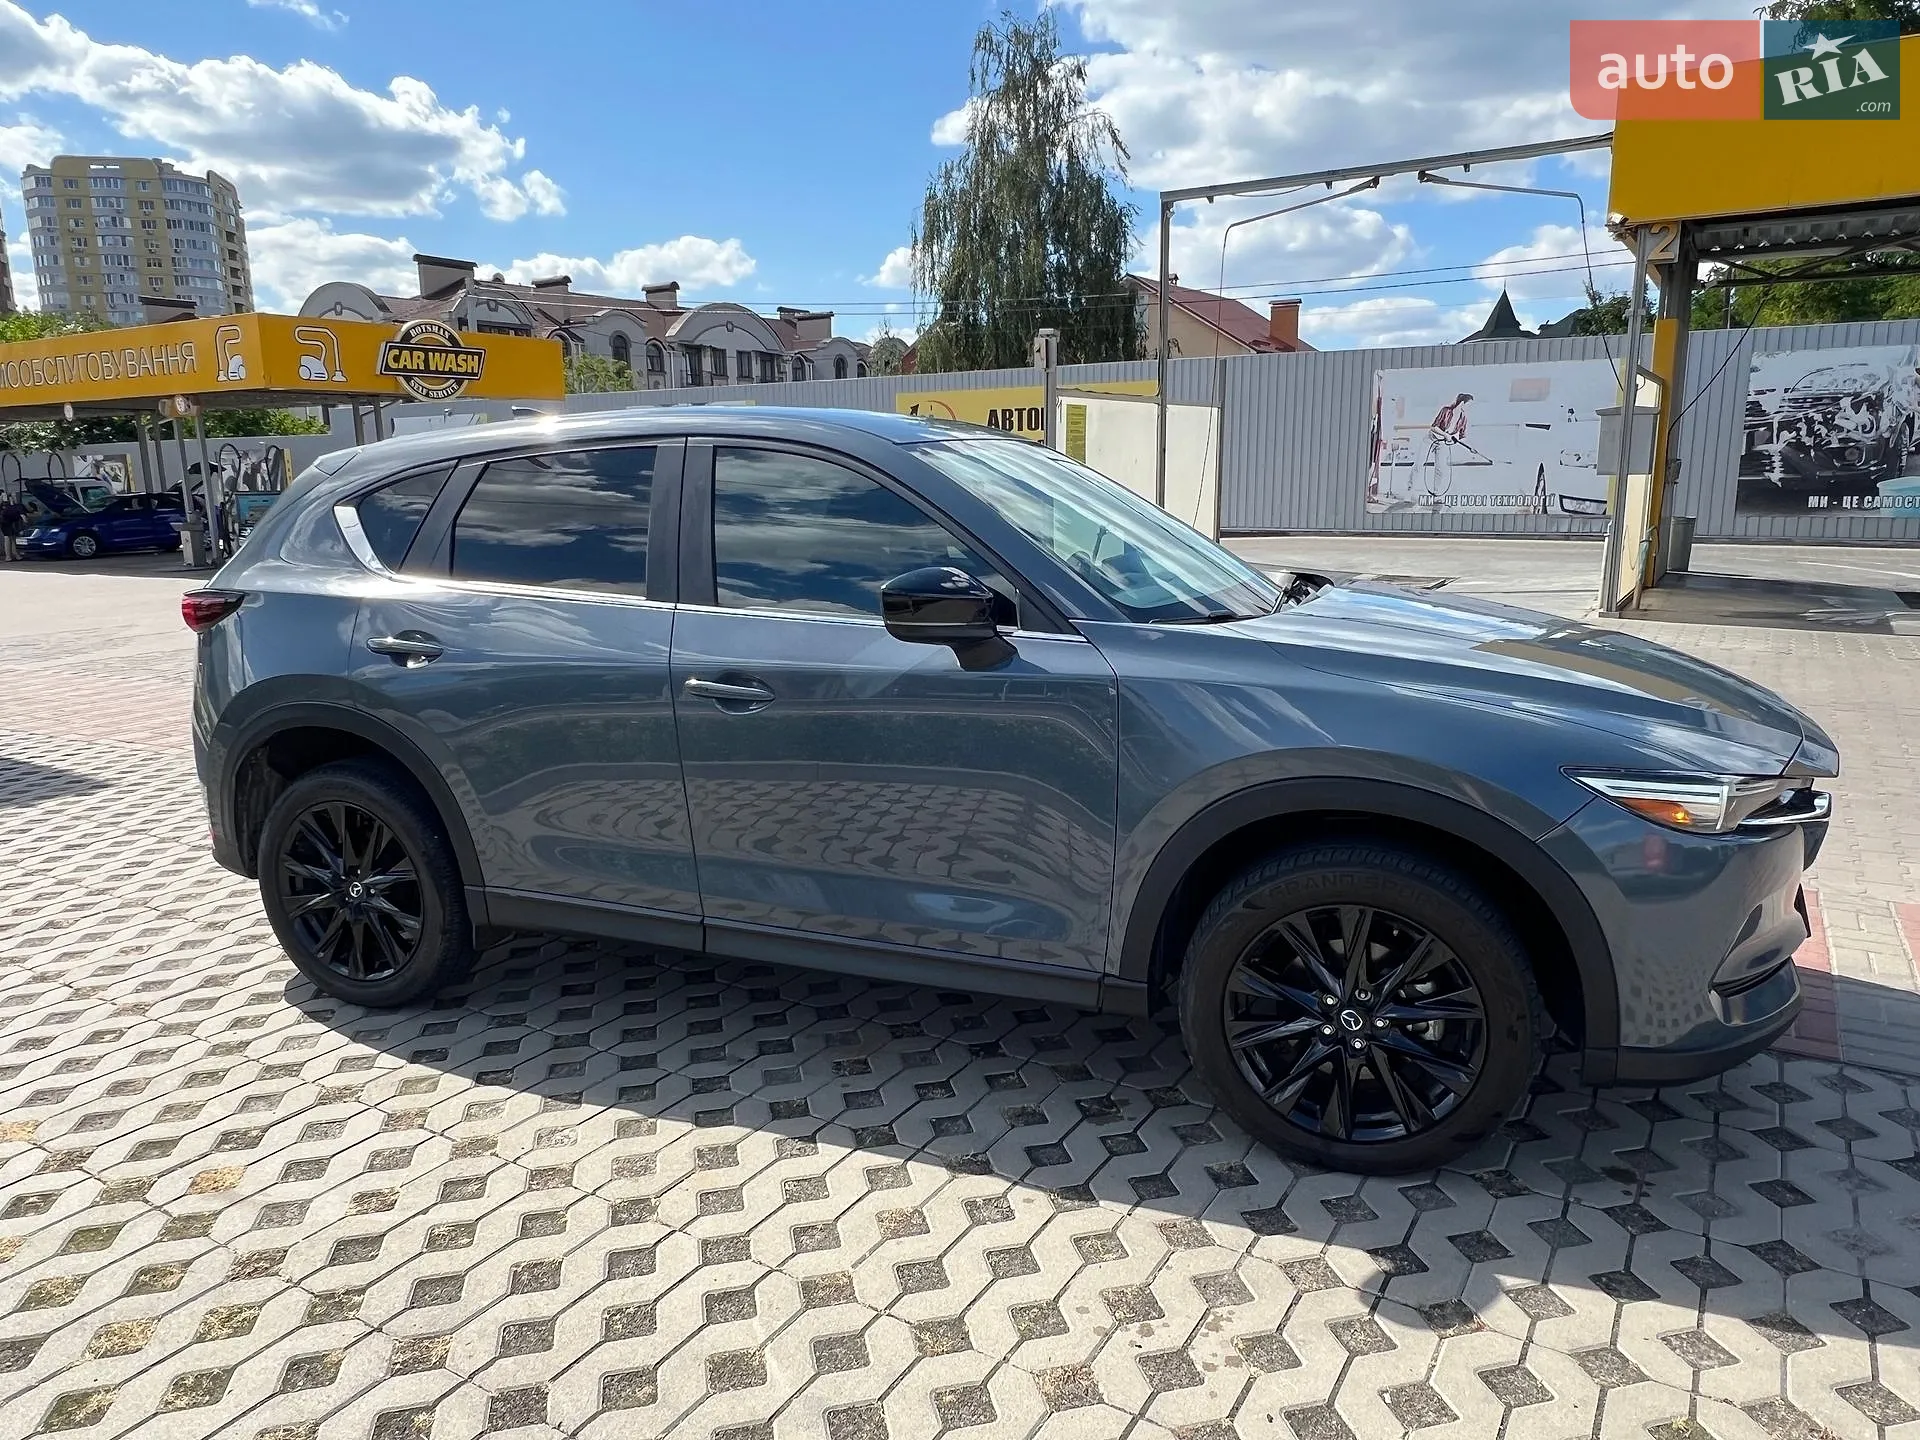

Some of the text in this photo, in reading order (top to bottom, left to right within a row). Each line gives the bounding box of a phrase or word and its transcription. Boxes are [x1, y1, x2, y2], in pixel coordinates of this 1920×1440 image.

[1649, 222, 1678, 254] 2
[387, 349, 479, 373] CAR WASH
[409, 379, 459, 398] SELF SERVICE
[1445, 495, 1458, 508] ЦЕ
[1461, 495, 1487, 506] НОВІ
[1490, 493, 1556, 506] ТЕХНОЛОГІЇ
[1808, 496, 1828, 508] МИ
[1842, 496, 1859, 509] ЦЕ
